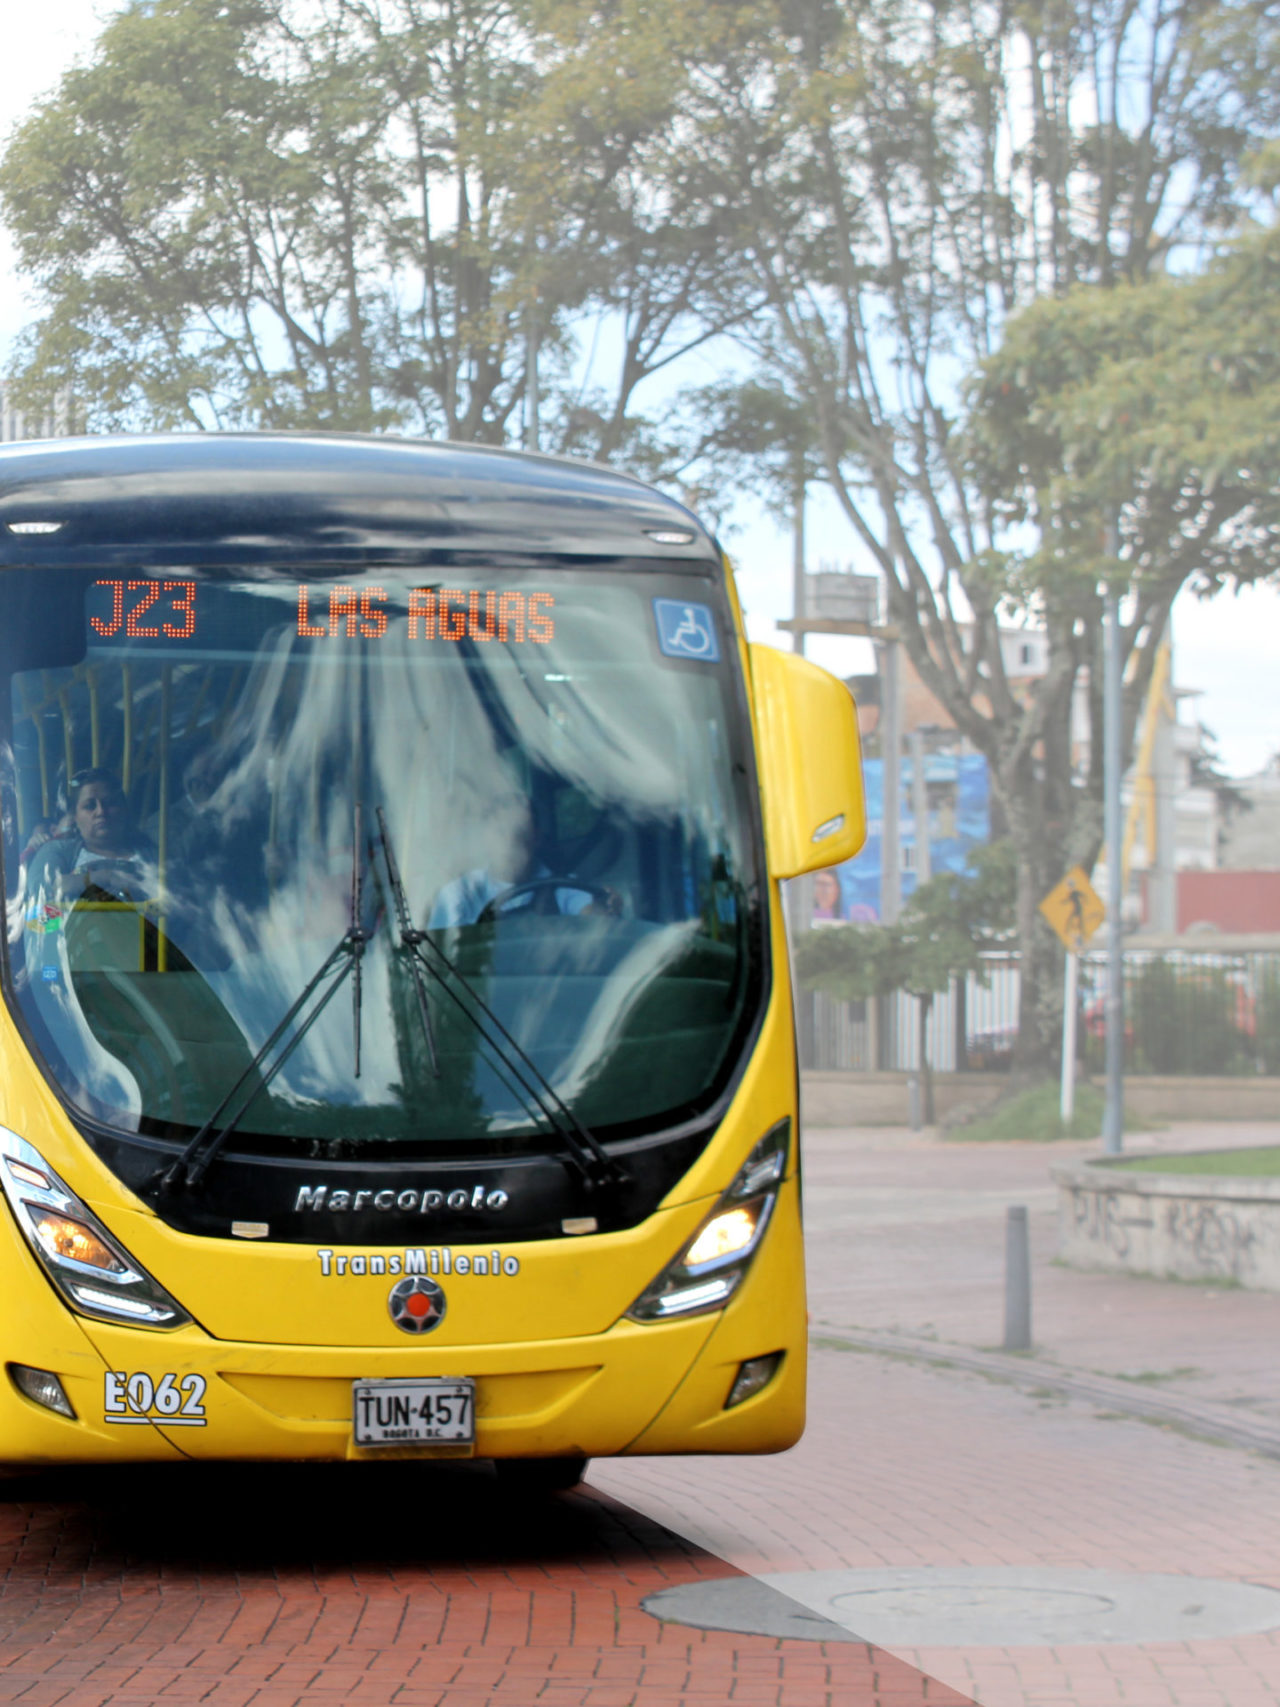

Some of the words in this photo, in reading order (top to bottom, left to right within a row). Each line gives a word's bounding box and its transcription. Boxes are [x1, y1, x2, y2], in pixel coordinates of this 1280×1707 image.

[90, 580, 196, 638] J23
[298, 584, 388, 638] LAS
[408, 587, 555, 643] AGUAS
[294, 1185, 509, 1214] Marcopolo
[317, 1248, 520, 1277] TransMilenio
[104, 1371, 207, 1416] E062
